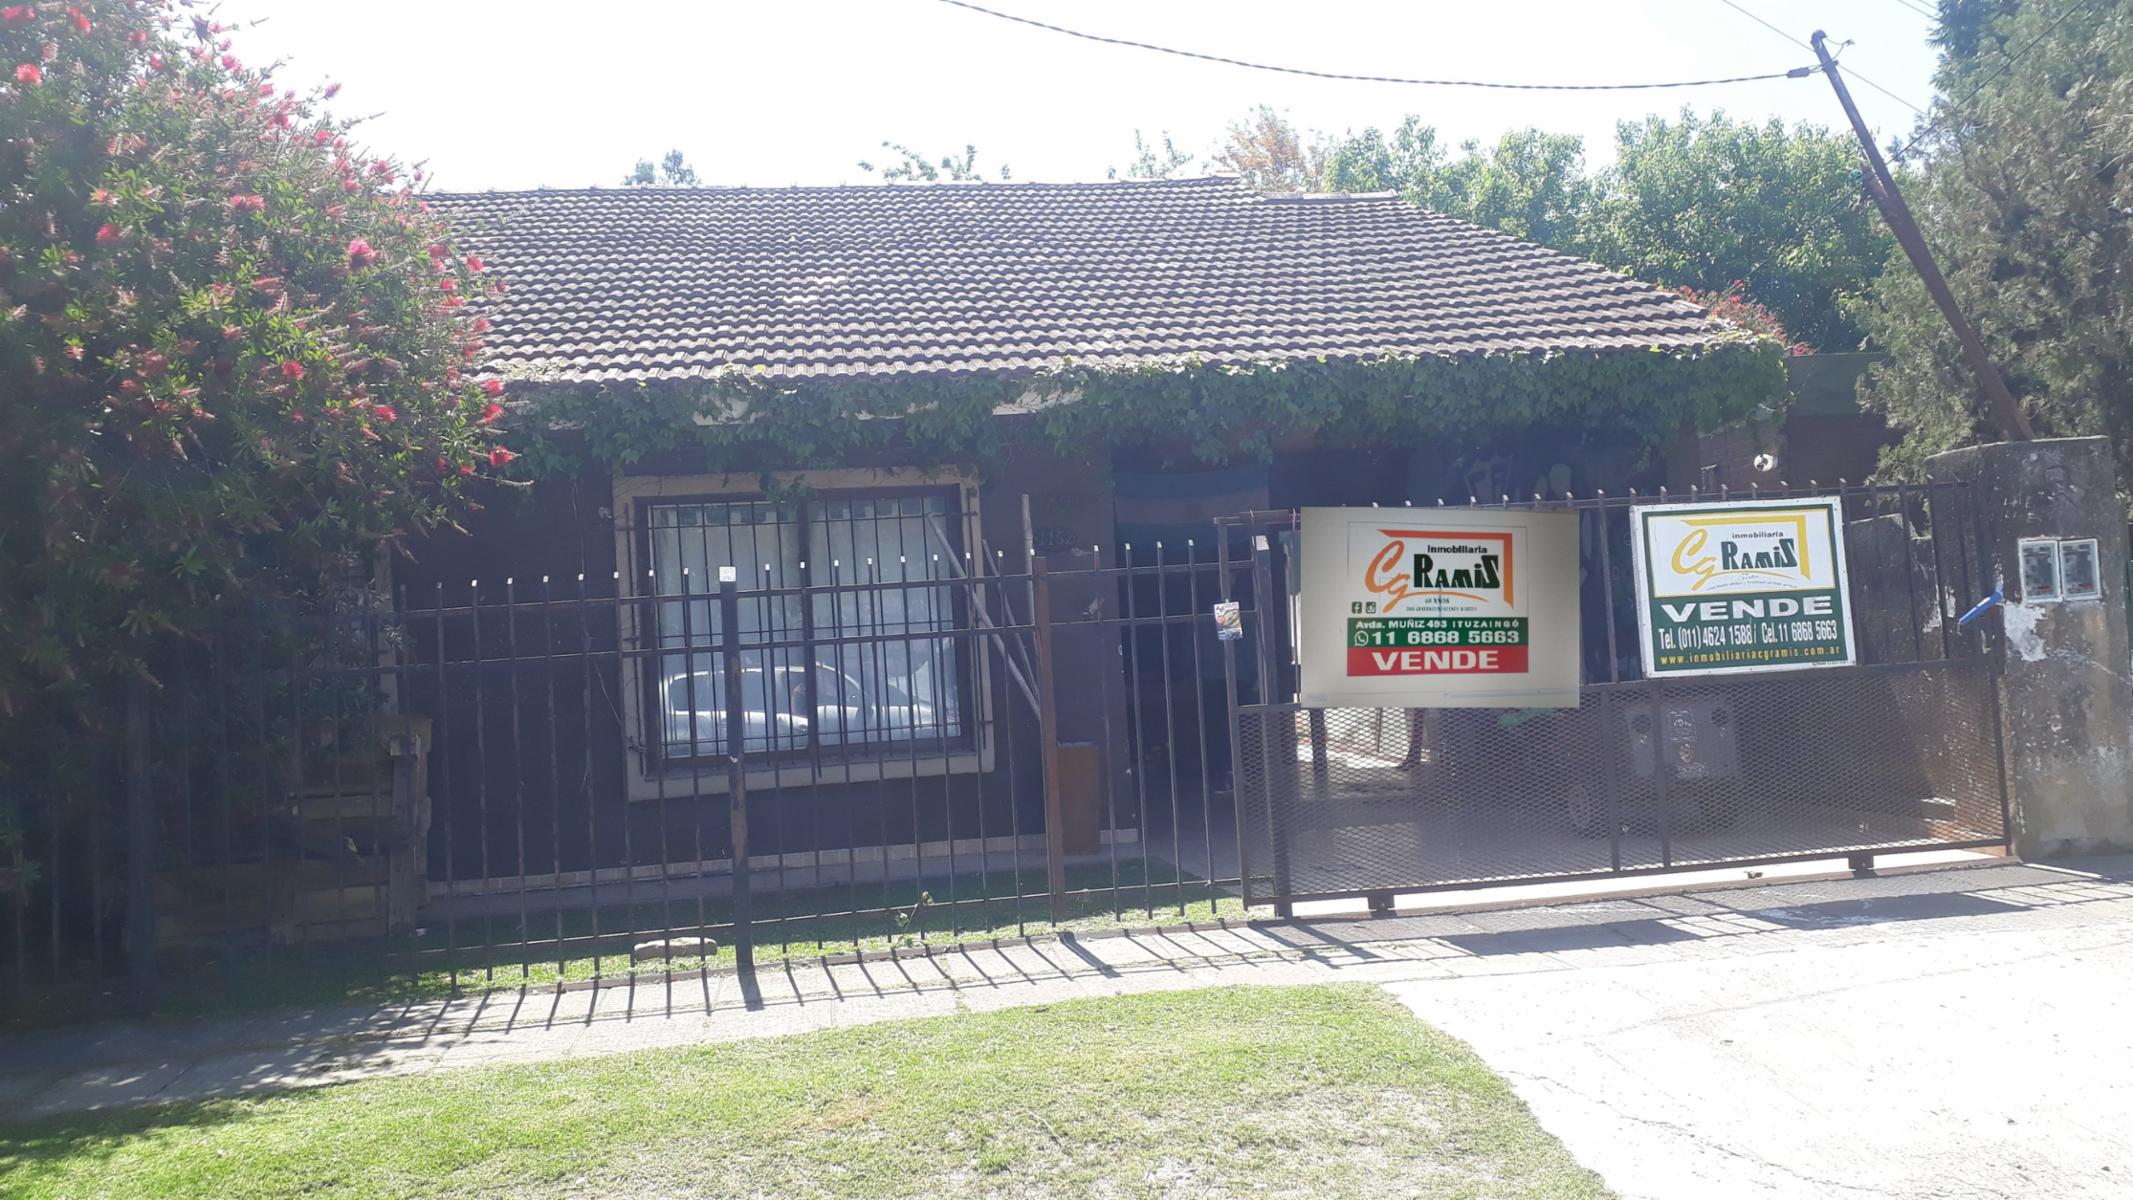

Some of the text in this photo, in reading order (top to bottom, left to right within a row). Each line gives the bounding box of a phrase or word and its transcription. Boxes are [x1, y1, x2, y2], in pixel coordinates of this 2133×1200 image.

[1731, 530, 1784, 540] inmobiliaria
[1660, 595, 1833, 623] VENDE
[1355, 620, 1386, 629] Avda.
[1388, 618, 1425, 629] MUÑIZ
[1452, 619, 1519, 628] ITUZAINGÓ
[1371, 630, 1520, 645] 11 6868 5663
[1658, 619, 1838, 651] Tel. (011) 4624 1588 Cel. 11 6868 5663
[1371, 650, 1500, 671] VENDE
